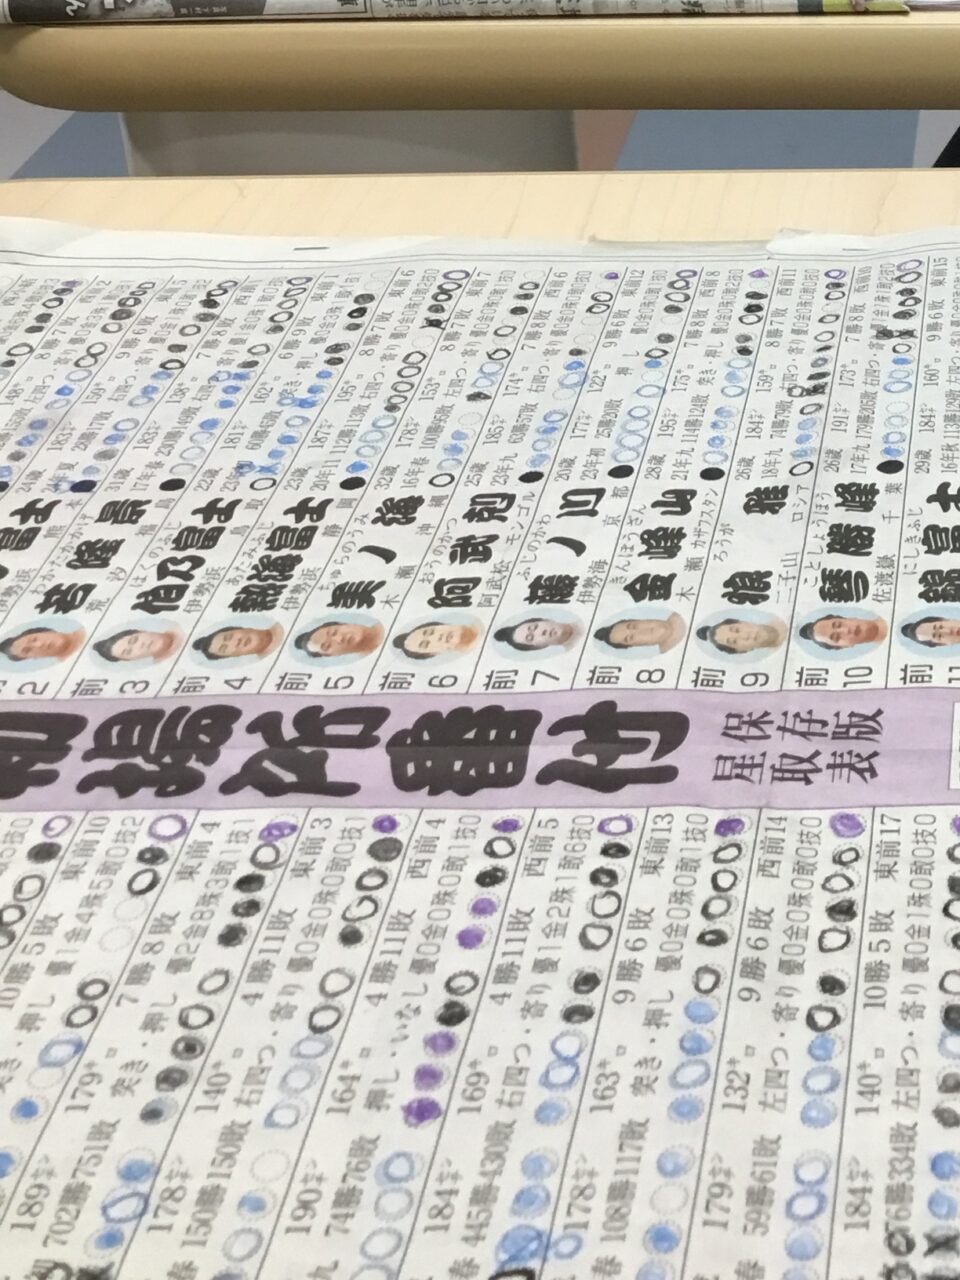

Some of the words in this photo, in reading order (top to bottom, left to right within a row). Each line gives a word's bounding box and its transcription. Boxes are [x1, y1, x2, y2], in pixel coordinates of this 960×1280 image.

[523, 487, 607, 604] 藤ノ川
[623, 489, 697, 603] 金峰山
[721, 484, 790, 605] 狼雅
[819, 482, 879, 604] 琴勝峰
[175, 675, 253, 694] 前4
[277, 673, 356, 692] 前5
[379, 672, 457, 691] 前6
[483, 670, 559, 689] 前7
[586, 665, 665, 688] 前8
[690, 666, 769, 687] 前9
[795, 665, 873, 687] 前10
[71, 678, 149, 697] 前3
[721, 709, 884, 743] 保存版
[712, 750, 881, 785] 星取表
